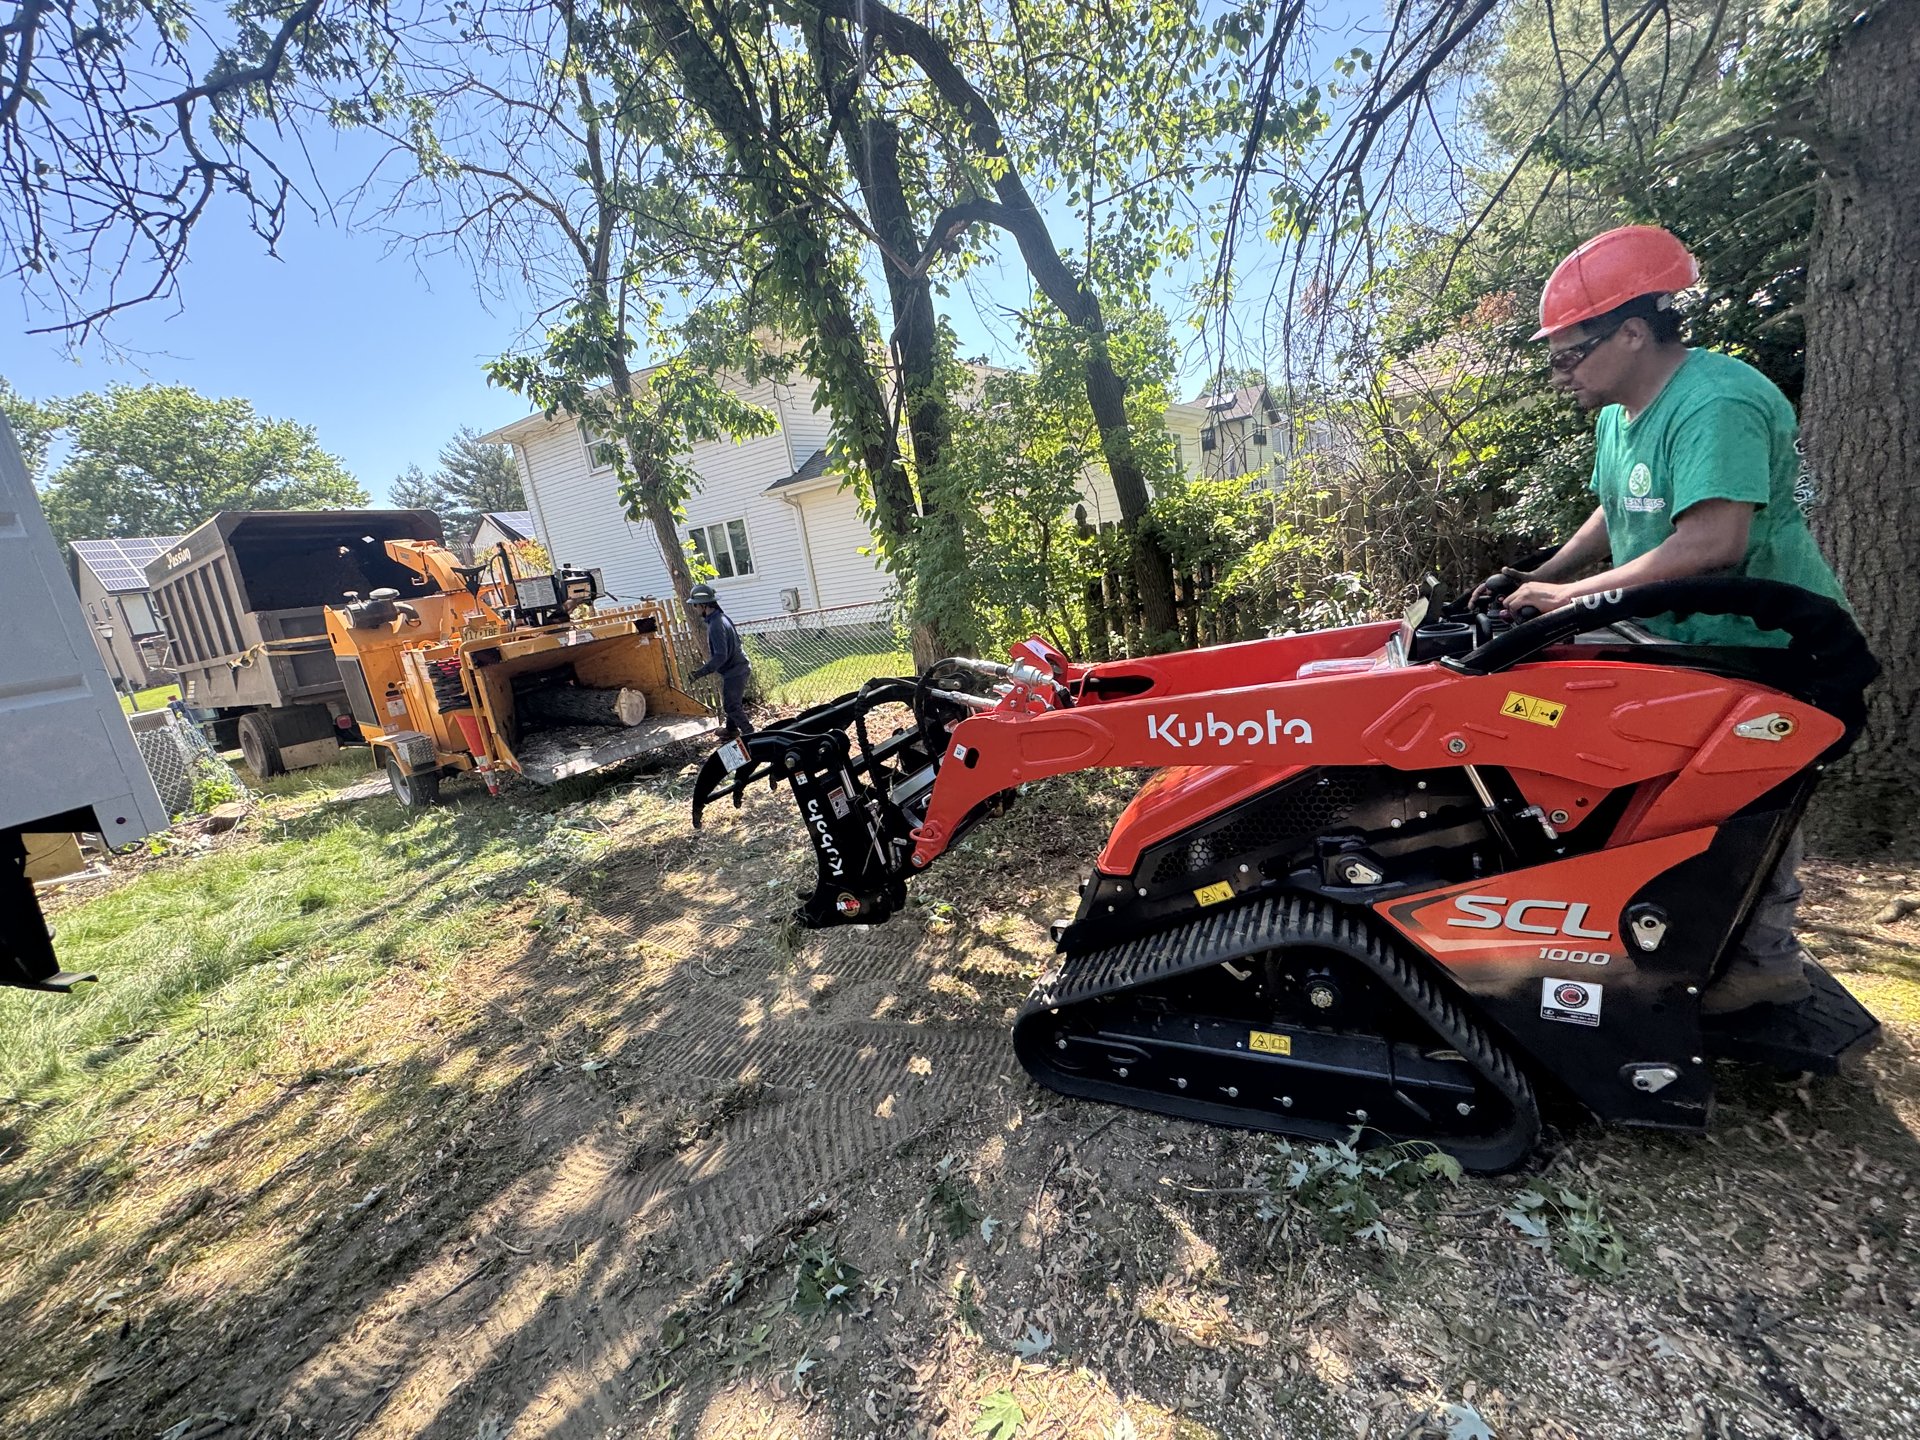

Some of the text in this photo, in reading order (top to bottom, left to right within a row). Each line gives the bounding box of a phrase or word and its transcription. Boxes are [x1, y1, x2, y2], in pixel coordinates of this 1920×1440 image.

[1147, 709, 1313, 747] Kubota
[807, 799, 844, 876] Kubota
[1446, 894, 1612, 940] SCL
[1538, 946, 1612, 966] 1000
